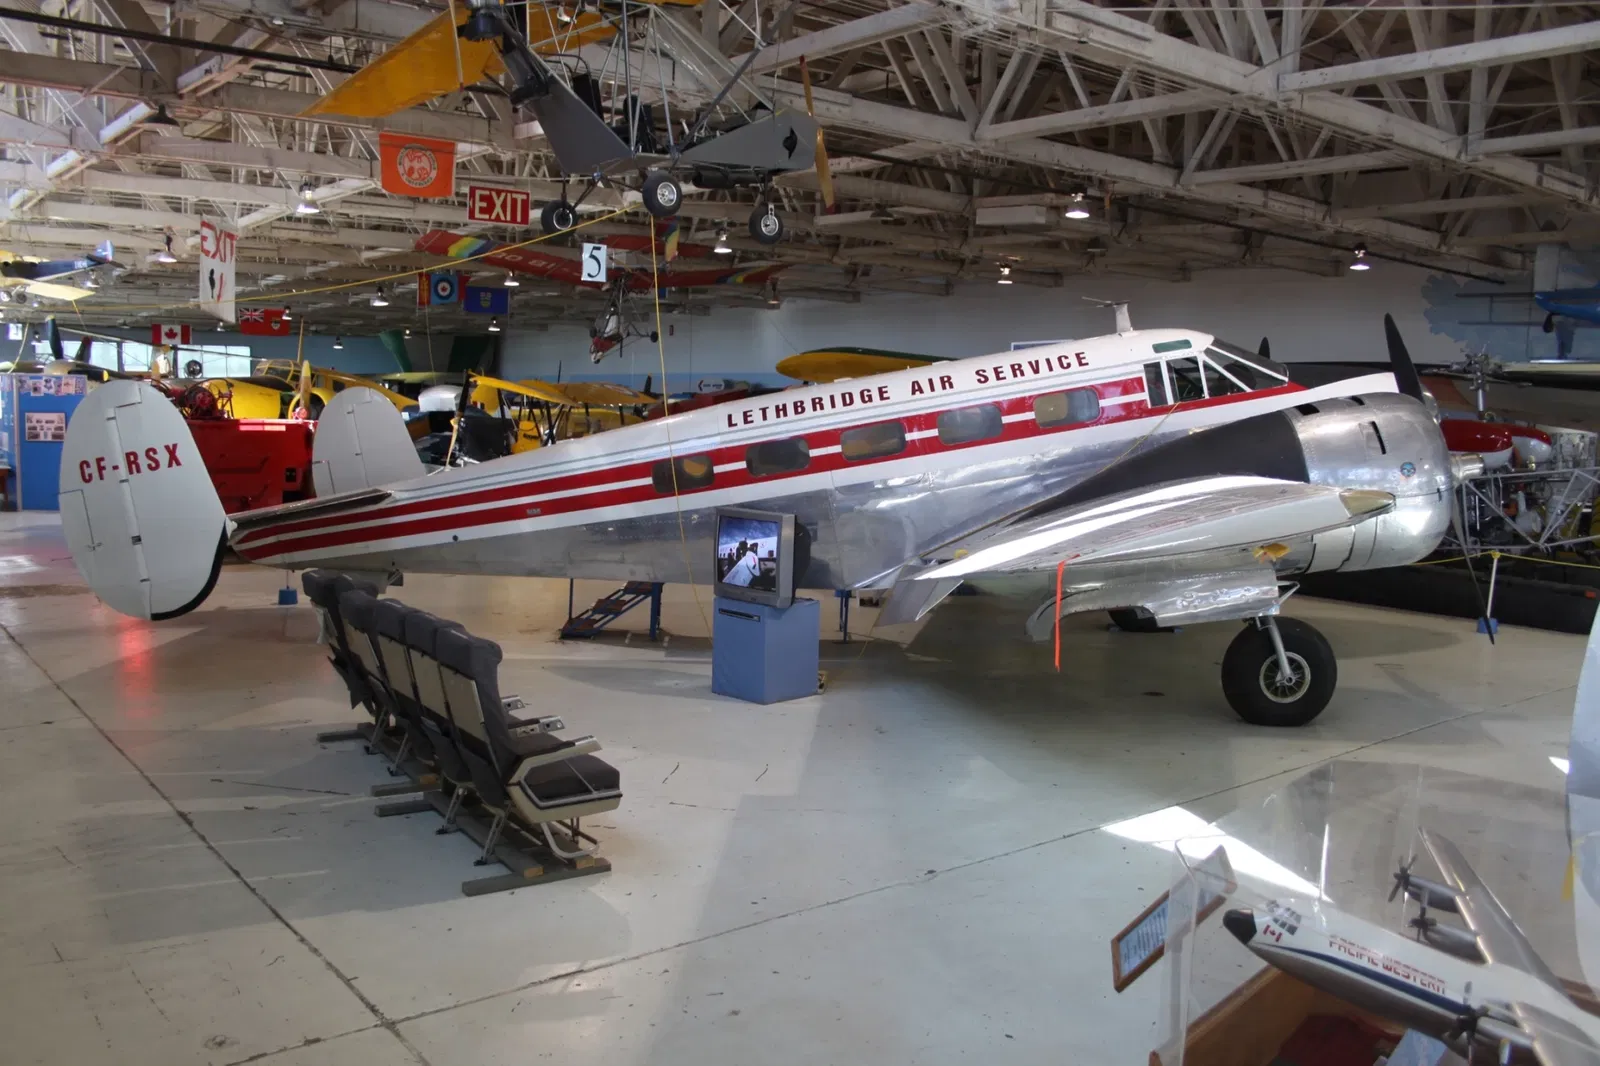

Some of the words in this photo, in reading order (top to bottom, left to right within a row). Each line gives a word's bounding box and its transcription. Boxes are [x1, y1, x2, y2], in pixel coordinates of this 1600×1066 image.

[474, 188, 528, 223] EXIT
[200, 220, 238, 264] EXIT
[586, 245, 602, 278] 5
[727, 384, 891, 428] LETHBRIDGE
[910, 373, 955, 396] AIR
[975, 351, 1090, 385] SERVICE
[79, 443, 183, 484] CF-RSX
